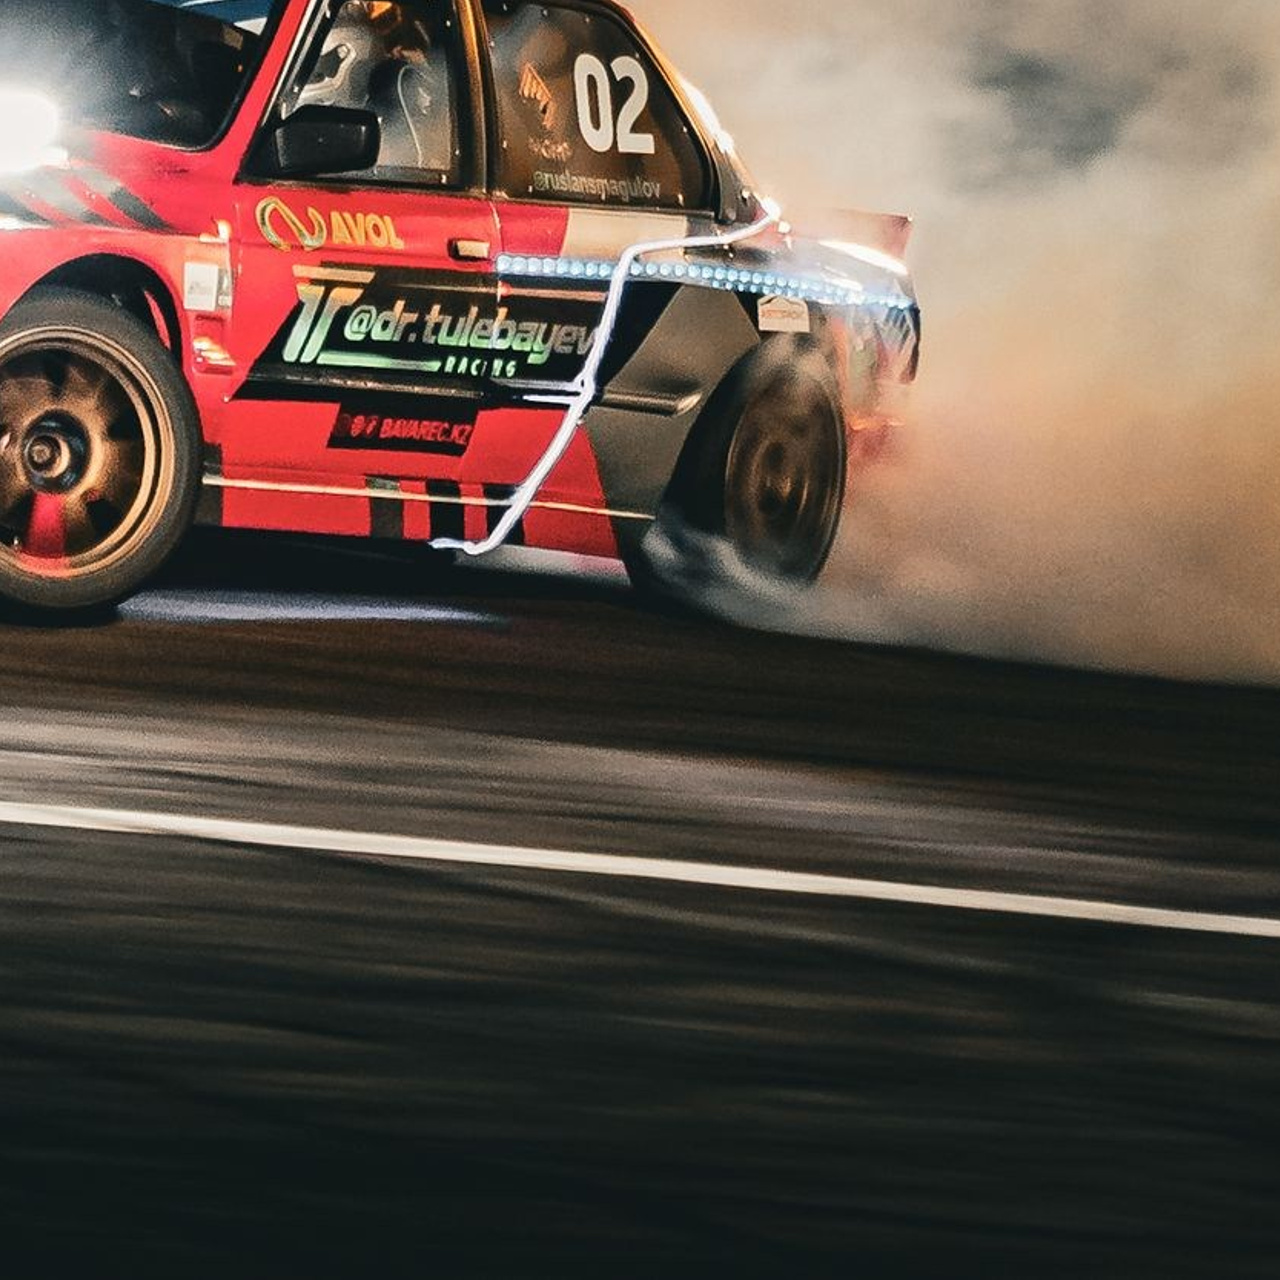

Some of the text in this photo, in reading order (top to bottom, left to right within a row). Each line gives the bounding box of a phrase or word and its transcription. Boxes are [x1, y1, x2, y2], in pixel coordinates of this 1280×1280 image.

[574, 53, 655, 154] 02
[330, 210, 405, 250] AVOL
[343, 299, 600, 365] @dr.tulebayev
